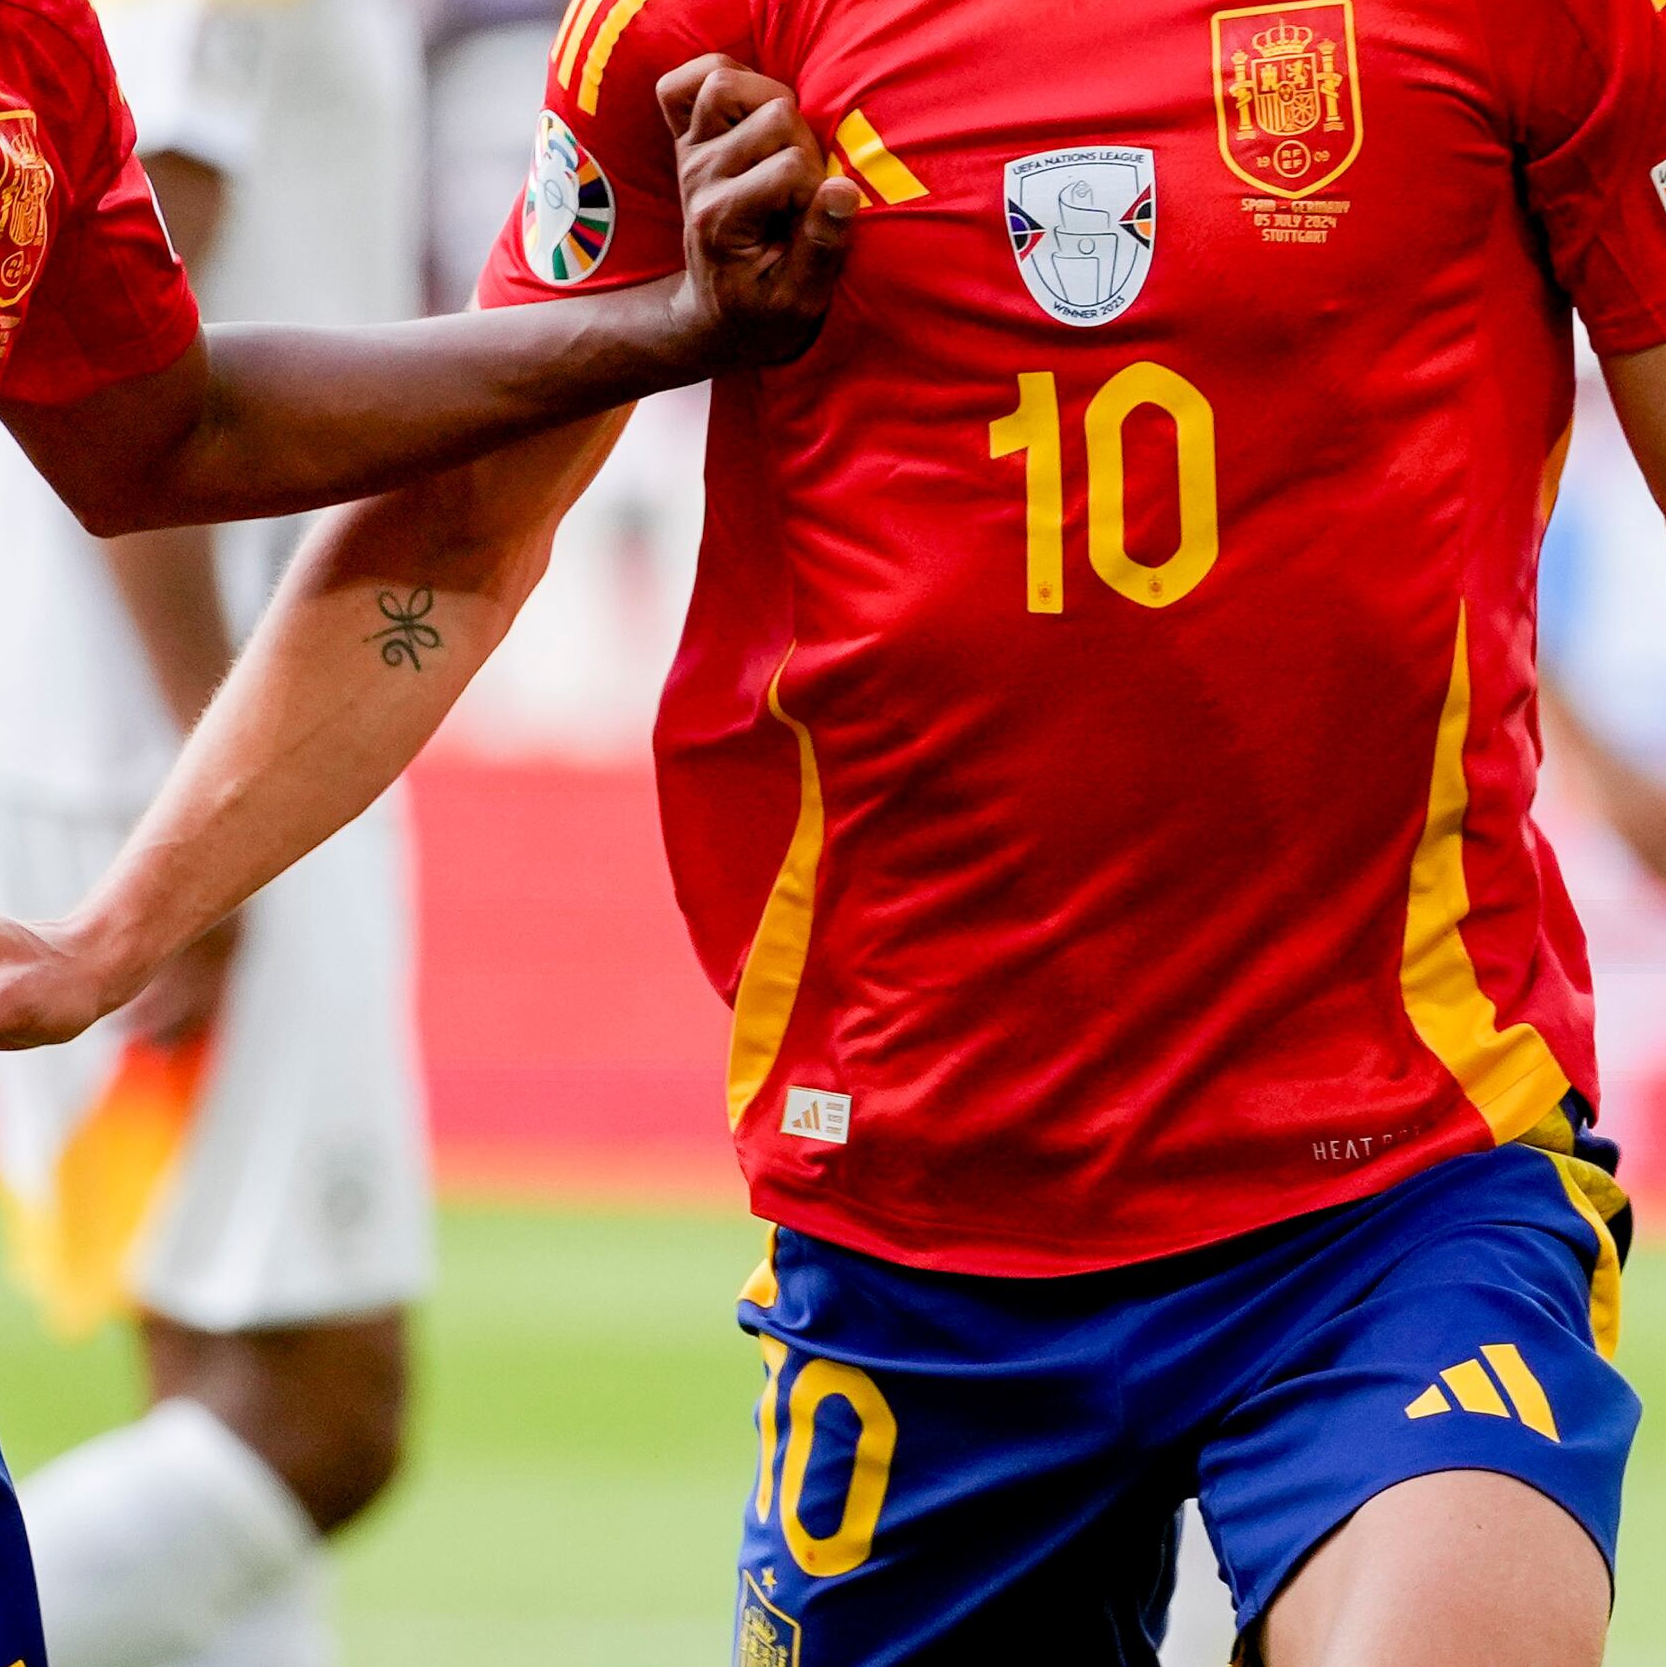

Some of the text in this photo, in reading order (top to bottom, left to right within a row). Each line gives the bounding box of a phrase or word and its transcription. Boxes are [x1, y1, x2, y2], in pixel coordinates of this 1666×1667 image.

[1013, 151, 1145, 175] UEFA NATIONS LEAGUE
[1254, 213, 1337, 228] 05 JULY 2024
[1261, 228, 1328, 243] STUTTGART
[1053, 295, 1125, 319] WINNER 2023
[988, 360, 1219, 616] 10
[1313, 1137, 1373, 1161] HEAT
[755, 1334, 898, 1577] 10
